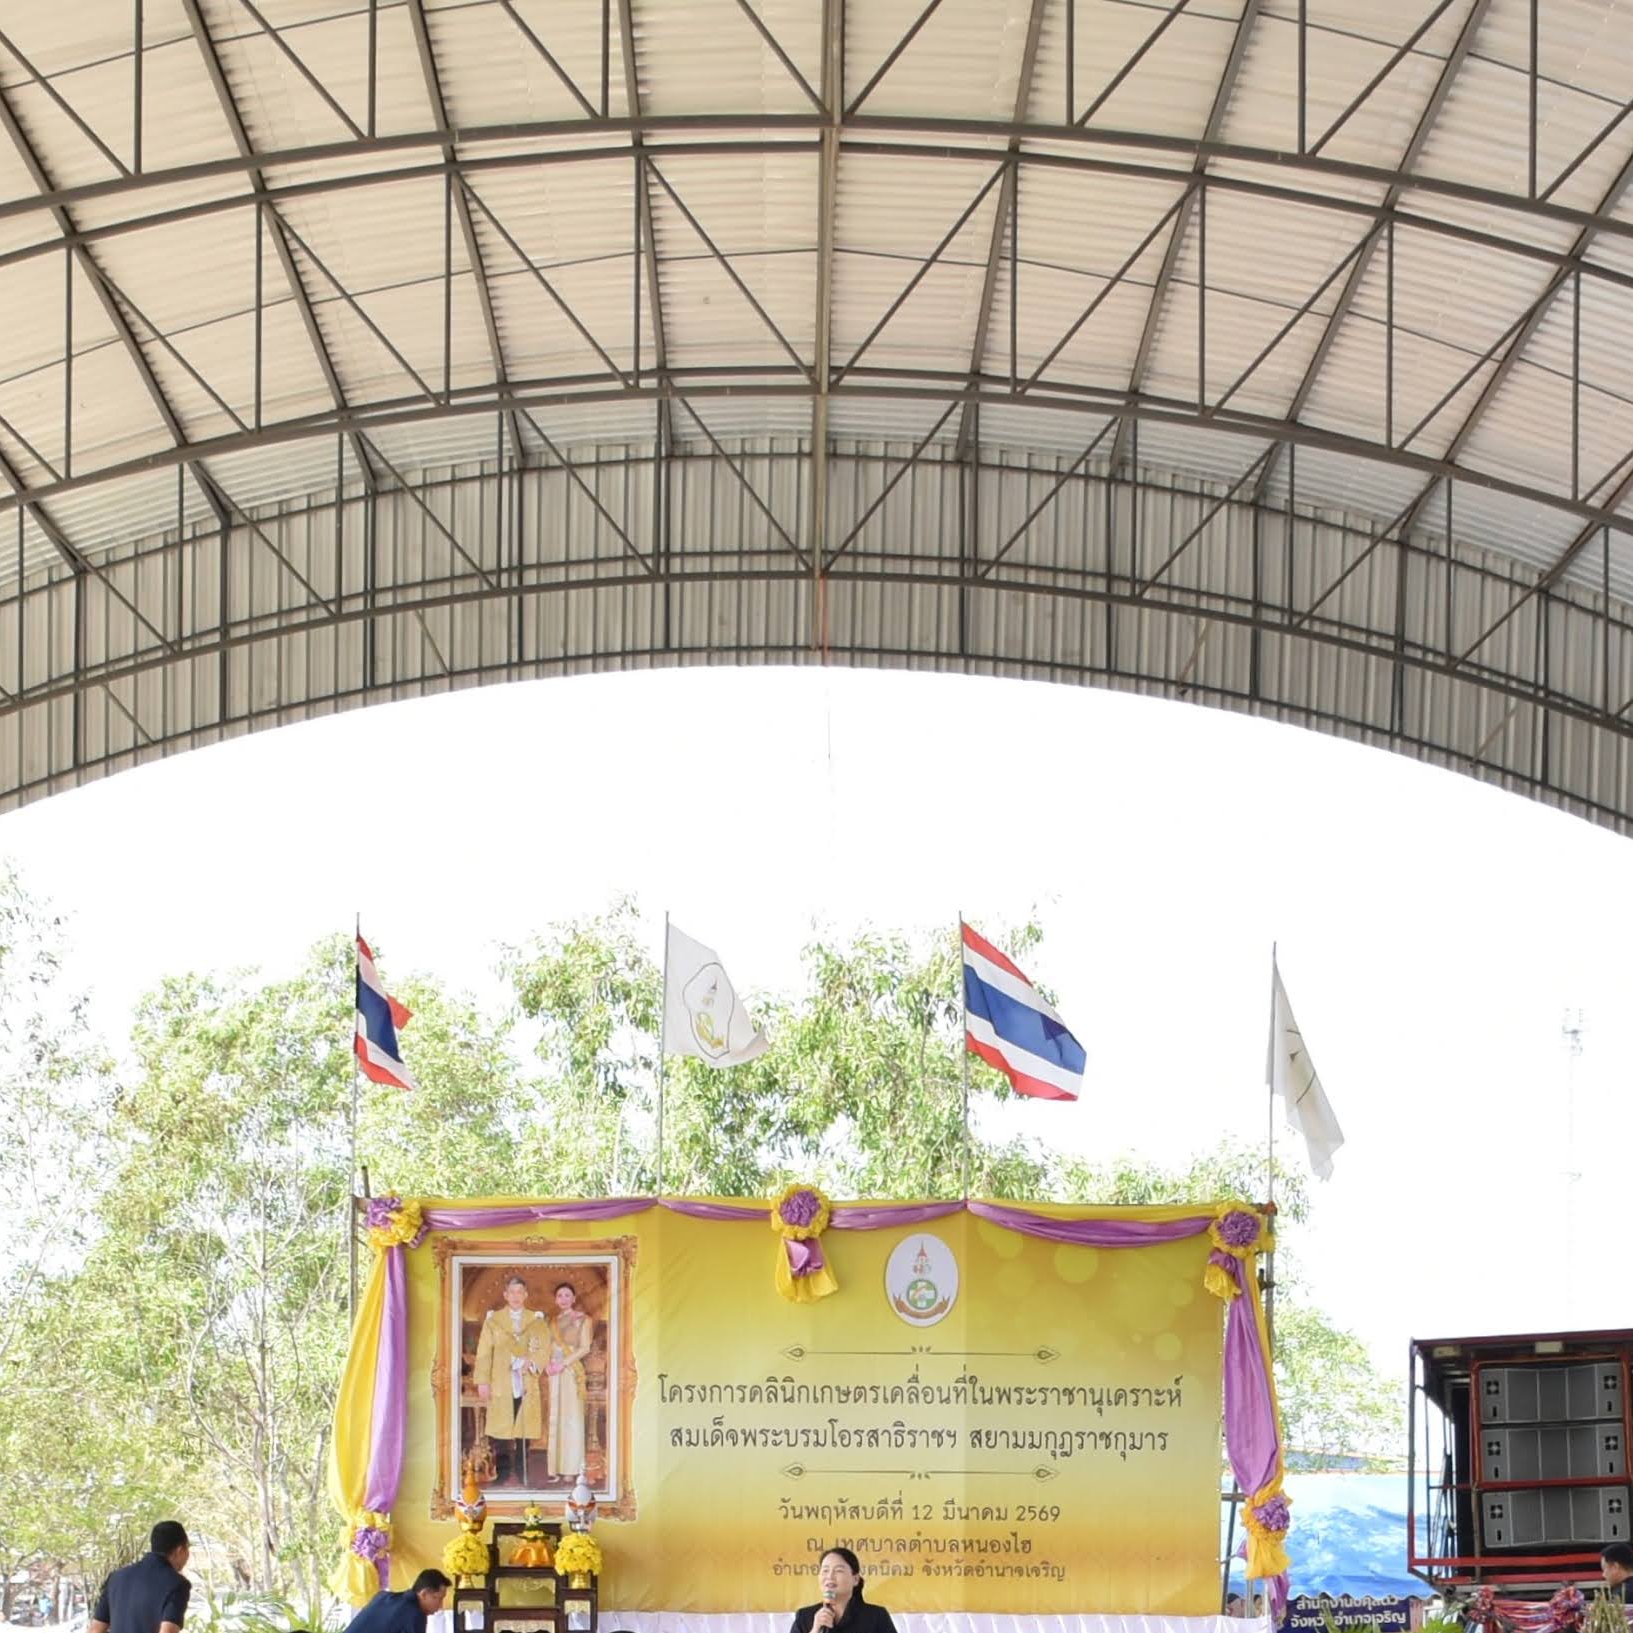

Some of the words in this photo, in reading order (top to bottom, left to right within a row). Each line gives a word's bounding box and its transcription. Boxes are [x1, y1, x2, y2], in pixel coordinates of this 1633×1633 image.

[657, 1364, 1184, 1417] โครงการคลินิกเกษตรเคลื่อนที่ในพระราชานุเคราะห์
[669, 1415, 958, 1449] สมเด็จพระบรมโอรสาธิราชฯ
[969, 1428, 1170, 1461] สยามมกุฎราชกุมาร
[778, 1490, 904, 1527] วันพฤหัสบดีที่
[912, 1504, 933, 1521] 12
[942, 1498, 1008, 1522] มีนาคม
[1016, 1505, 1061, 1522] 2569
[806, 1538, 824, 1553] ณ
[922, 1557, 1067, 1582] จังหวัดอำนาจเจริญ
